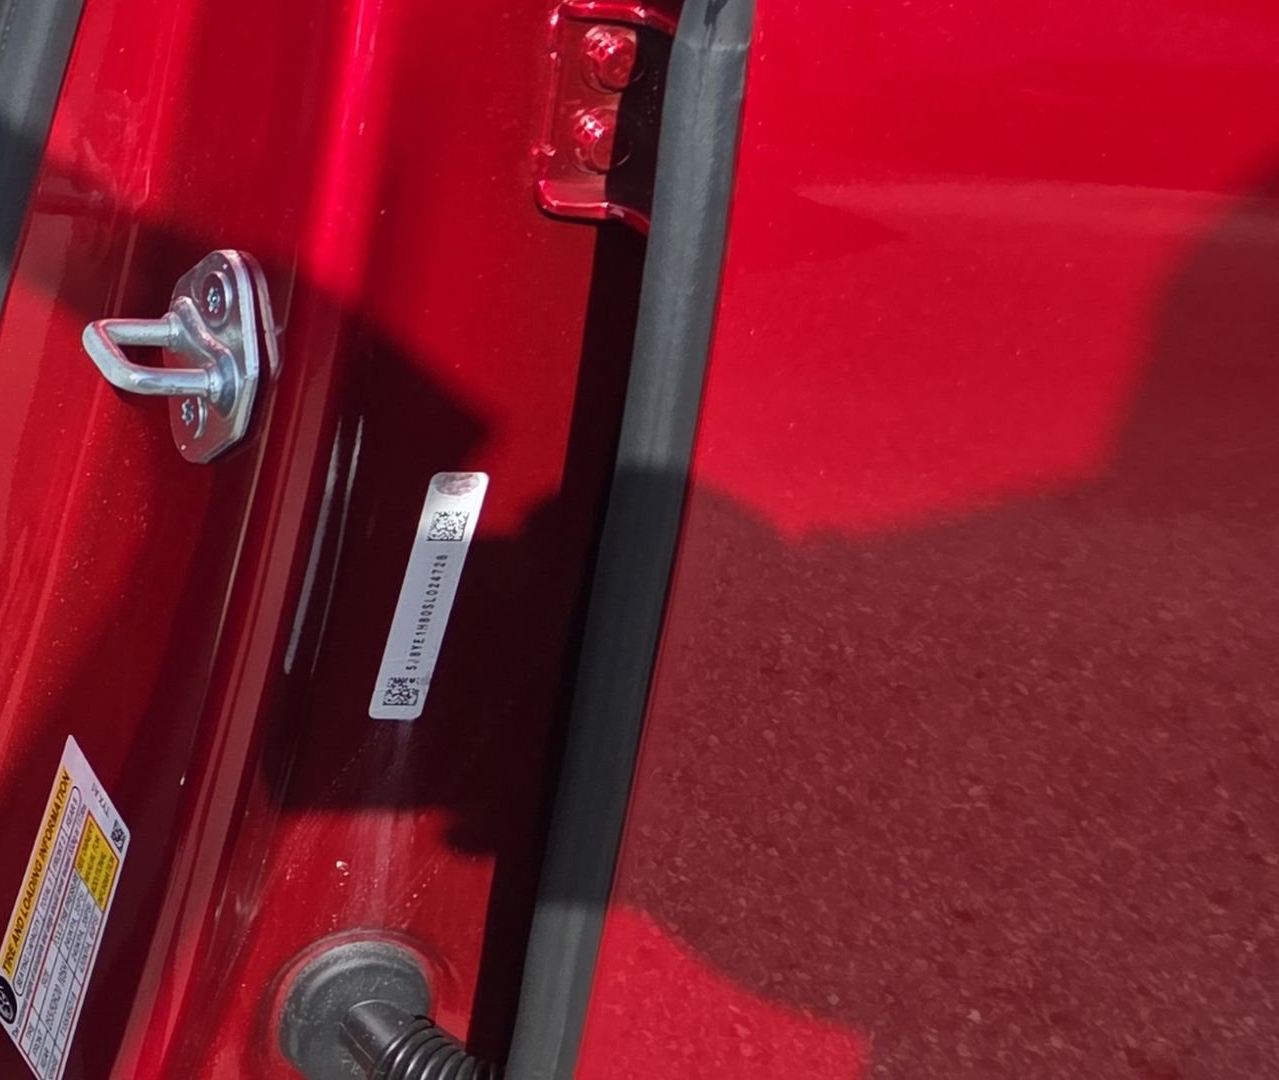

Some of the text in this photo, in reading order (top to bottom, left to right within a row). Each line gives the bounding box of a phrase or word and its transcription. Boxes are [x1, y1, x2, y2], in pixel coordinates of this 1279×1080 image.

[2, 769, 70, 977] TIRE AND LOADING INFORMATION
